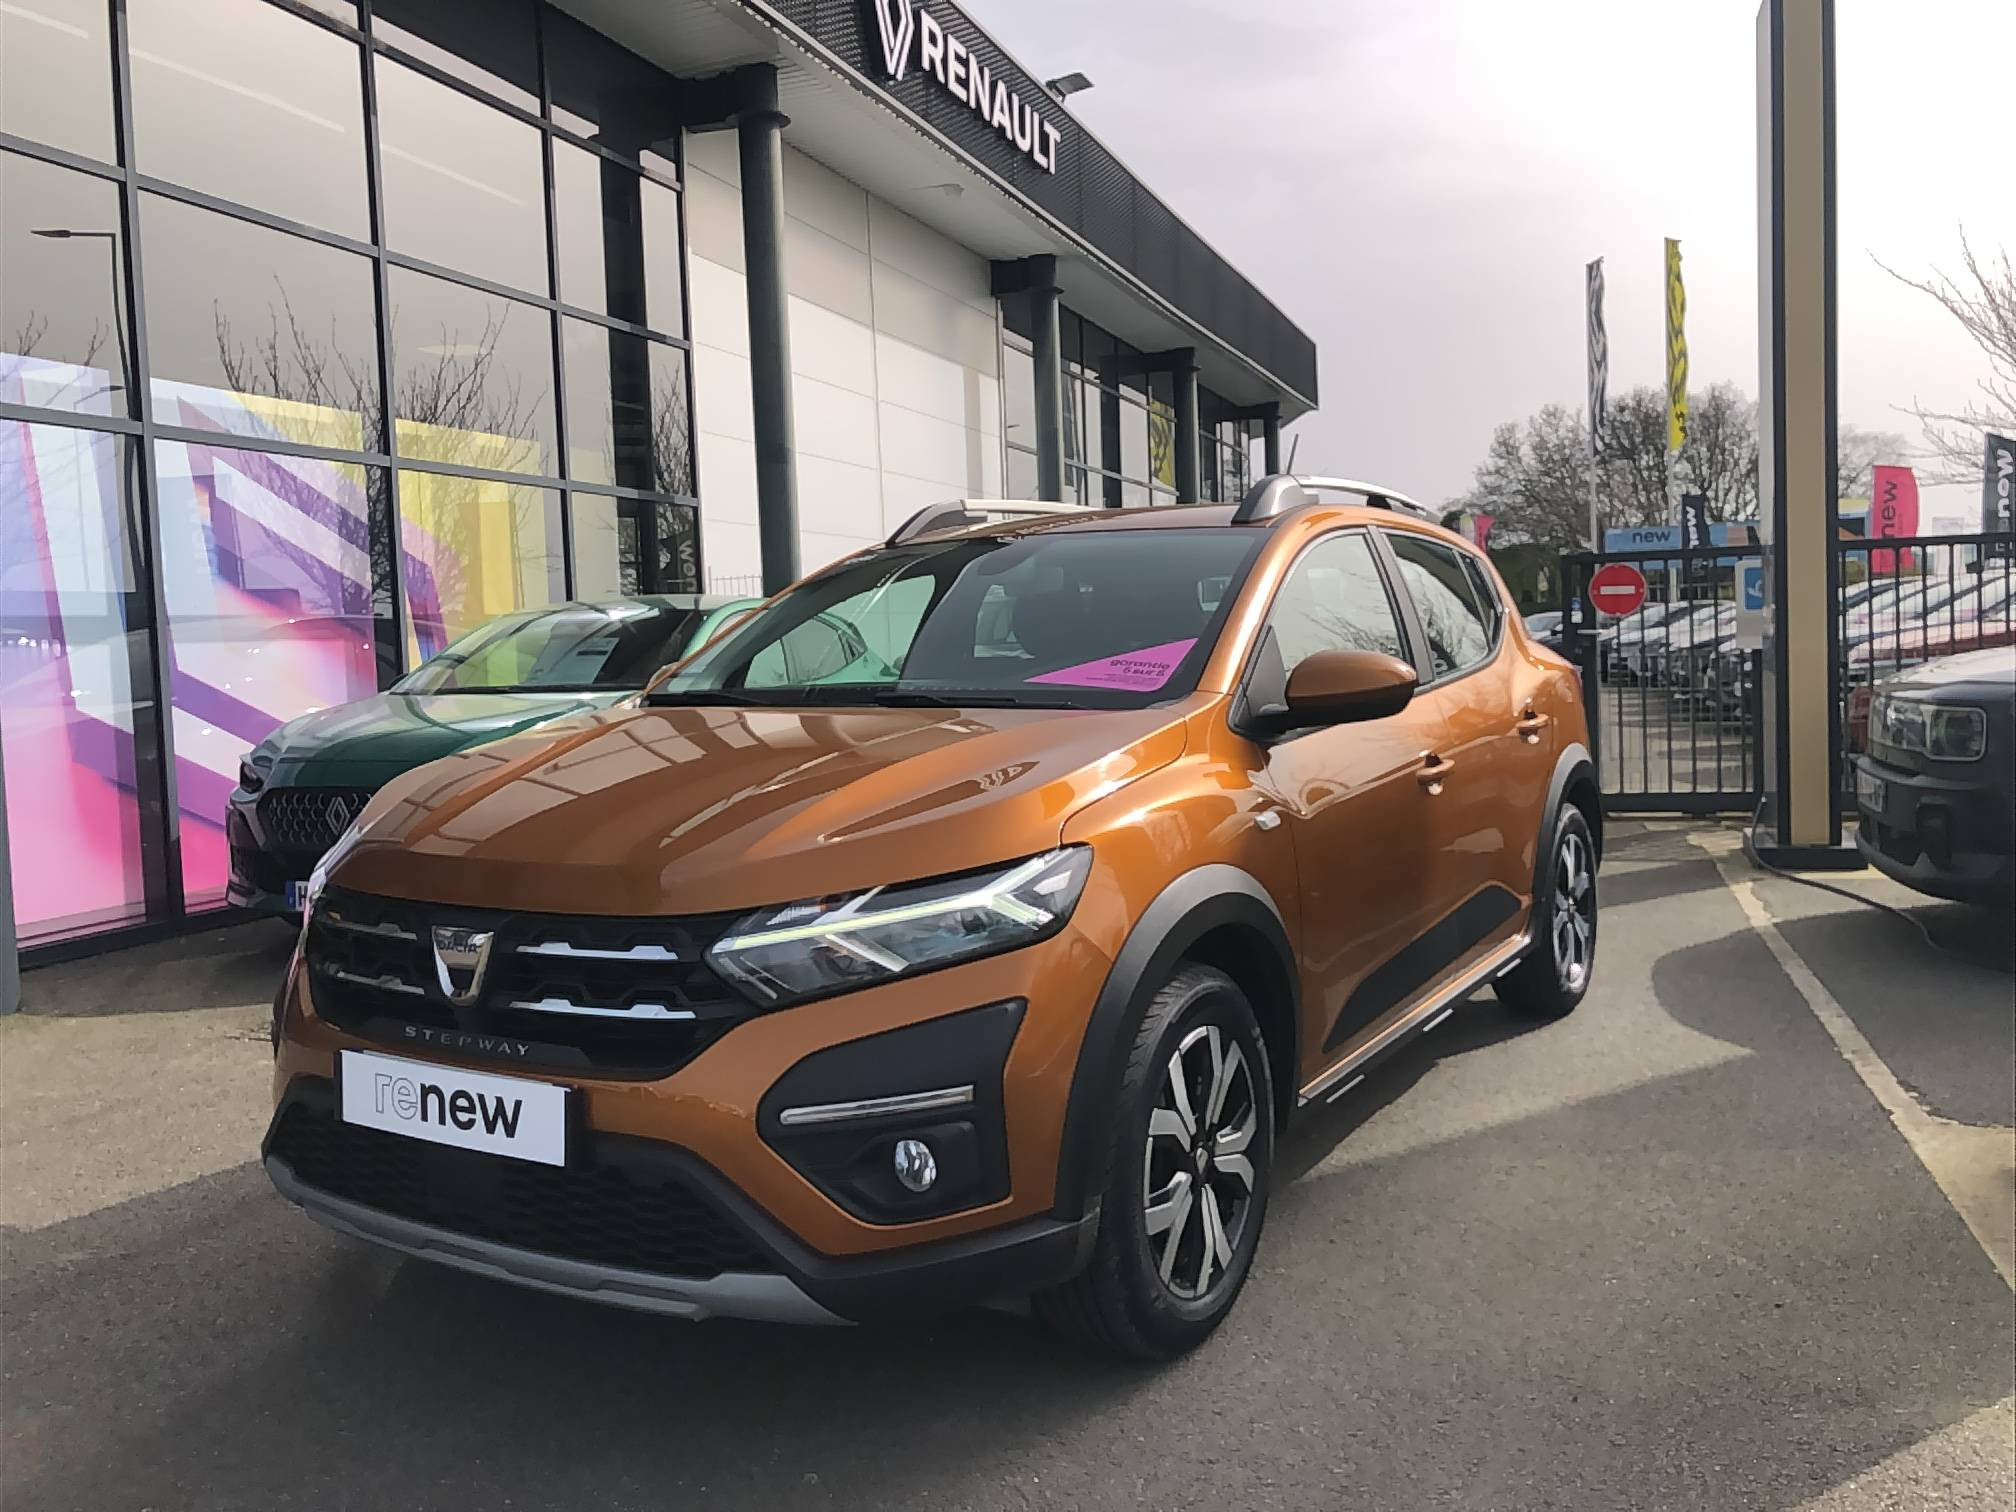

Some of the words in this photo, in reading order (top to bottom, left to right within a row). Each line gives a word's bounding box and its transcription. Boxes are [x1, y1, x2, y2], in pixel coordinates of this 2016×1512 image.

[920, 8, 1062, 175] RENAULT
[403, 1025, 529, 1056] STEPWAY
[374, 1072, 523, 1139] renew
